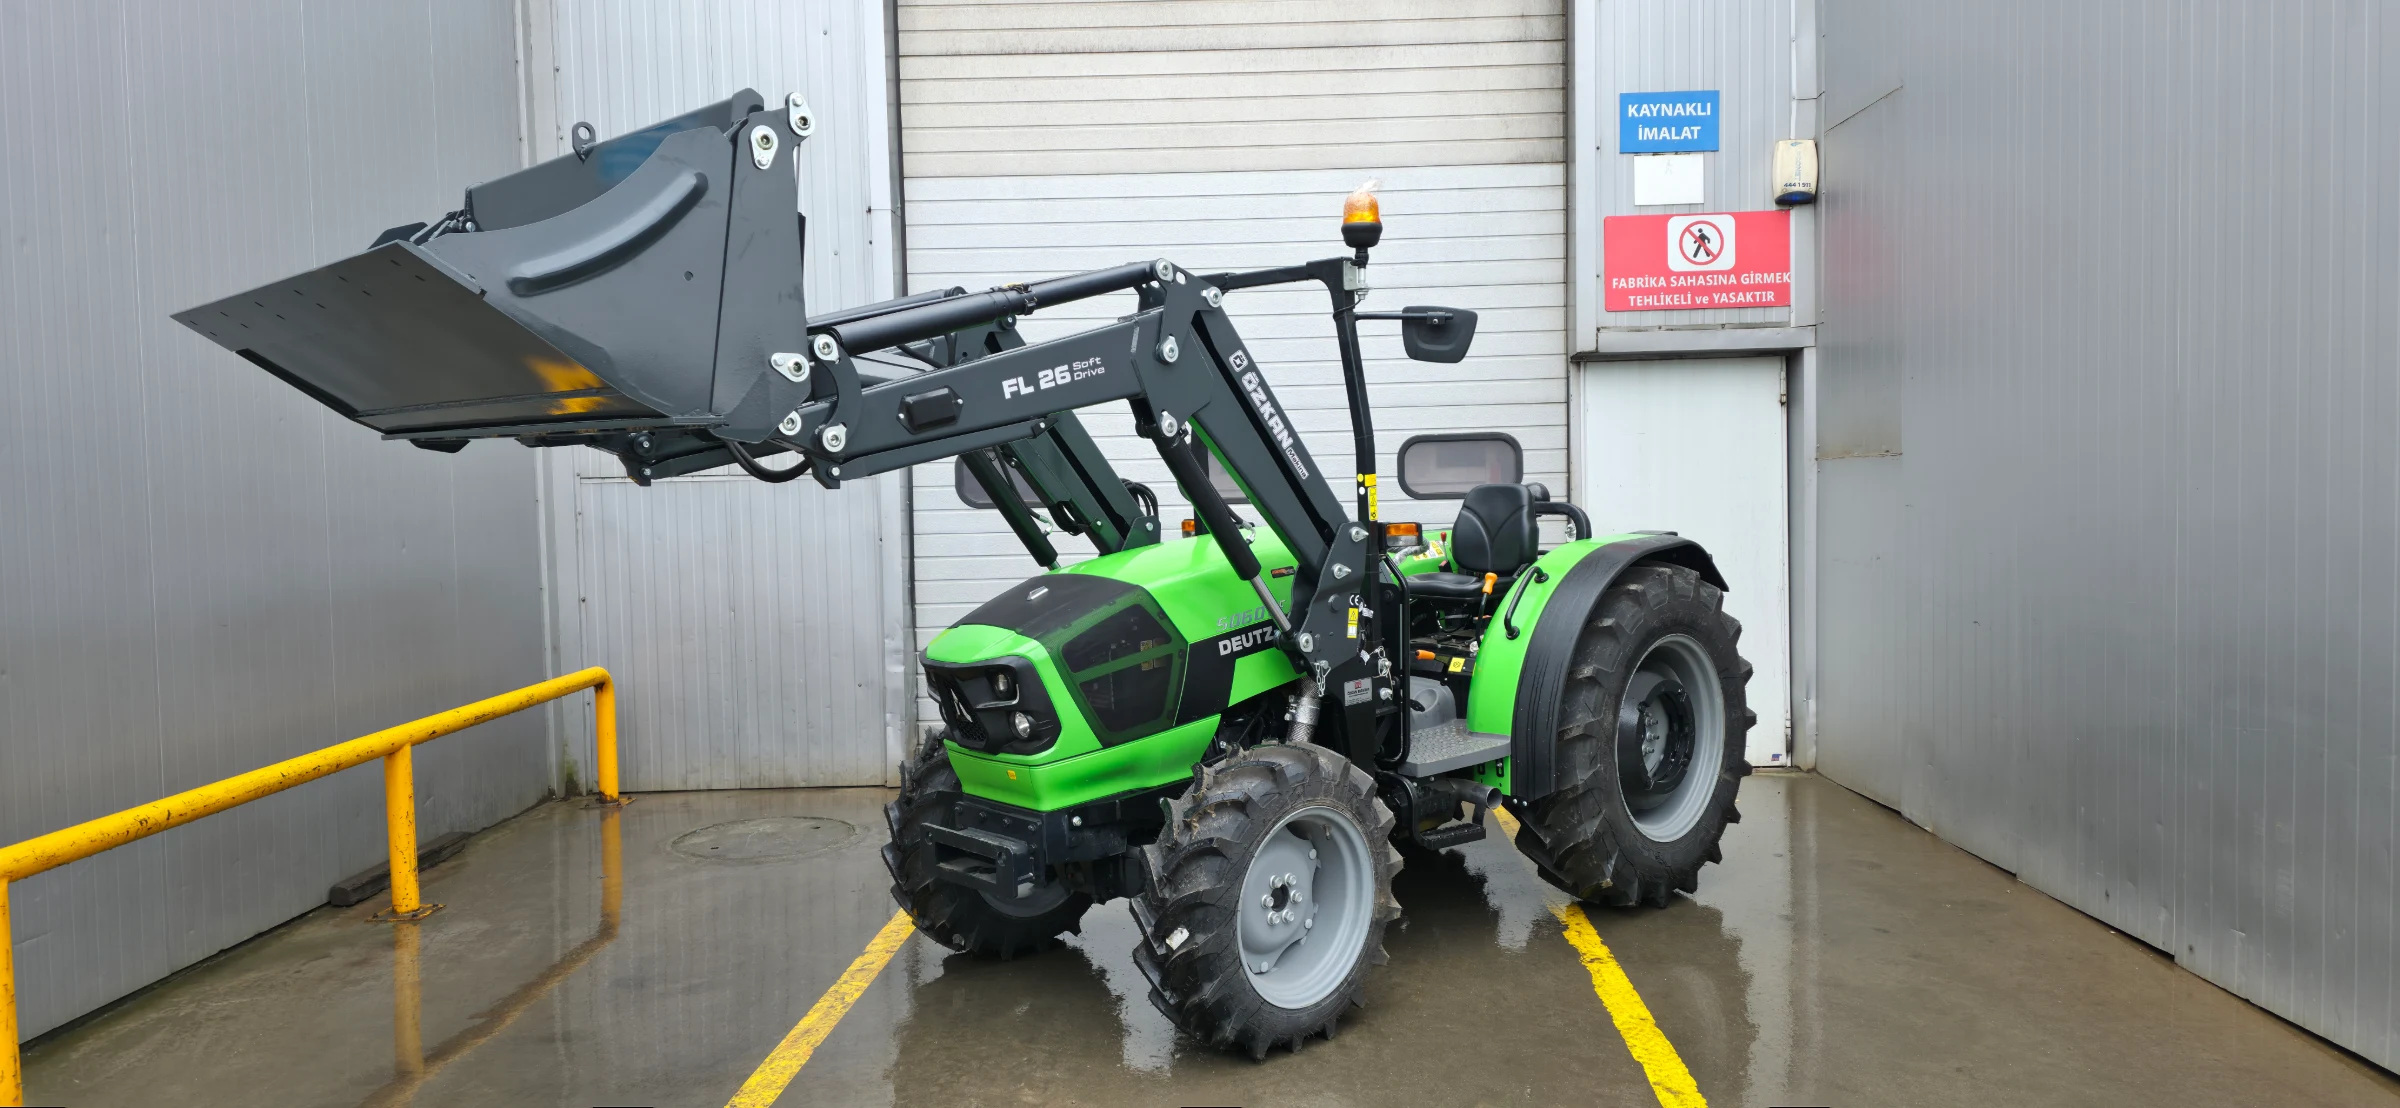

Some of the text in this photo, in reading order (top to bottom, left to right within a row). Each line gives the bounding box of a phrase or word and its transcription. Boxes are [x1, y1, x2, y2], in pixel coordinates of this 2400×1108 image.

[1628, 102, 1711, 117] KAYNAKLI
[1638, 124, 1701, 140] İMALAT
[1612, 271, 1791, 289] FABRİKA SAHASINA GİRMEK
[1629, 291, 1775, 306] TEHLİKELİ ve YASAKTIR
[1072, 356, 1102, 371] Soft
[1073, 366, 1105, 381] Drive
[1001, 364, 1072, 400] FL 26
[1241, 371, 1310, 480] ÖZKAN Makina
